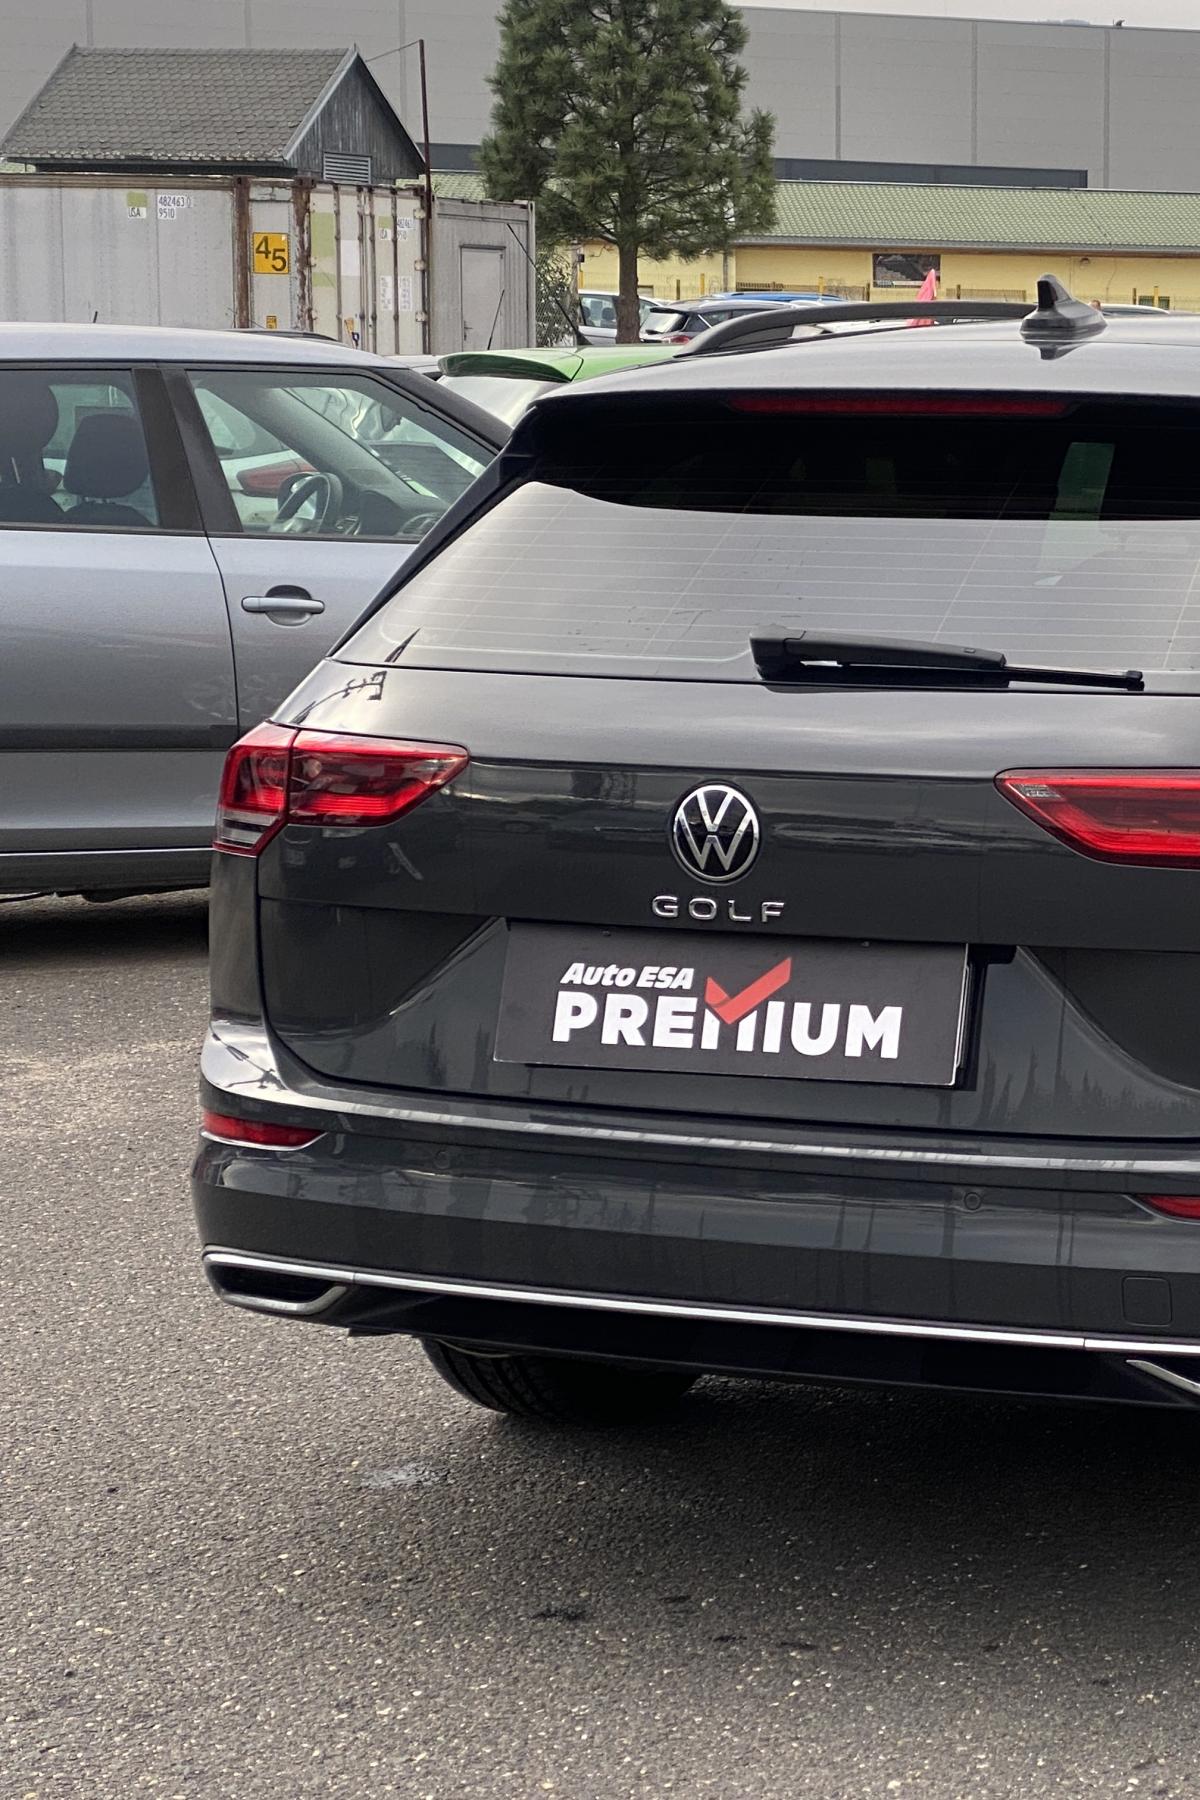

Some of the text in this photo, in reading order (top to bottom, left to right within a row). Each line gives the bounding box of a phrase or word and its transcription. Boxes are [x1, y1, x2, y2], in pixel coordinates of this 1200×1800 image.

[158, 195, 185, 207] 482463
[128, 207, 141, 217] USA
[158, 207, 175, 218] 9510
[651, 895, 786, 923] GOLF
[559, 961, 695, 990] Auto ESA
[552, 990, 904, 1060] PREMIUM
